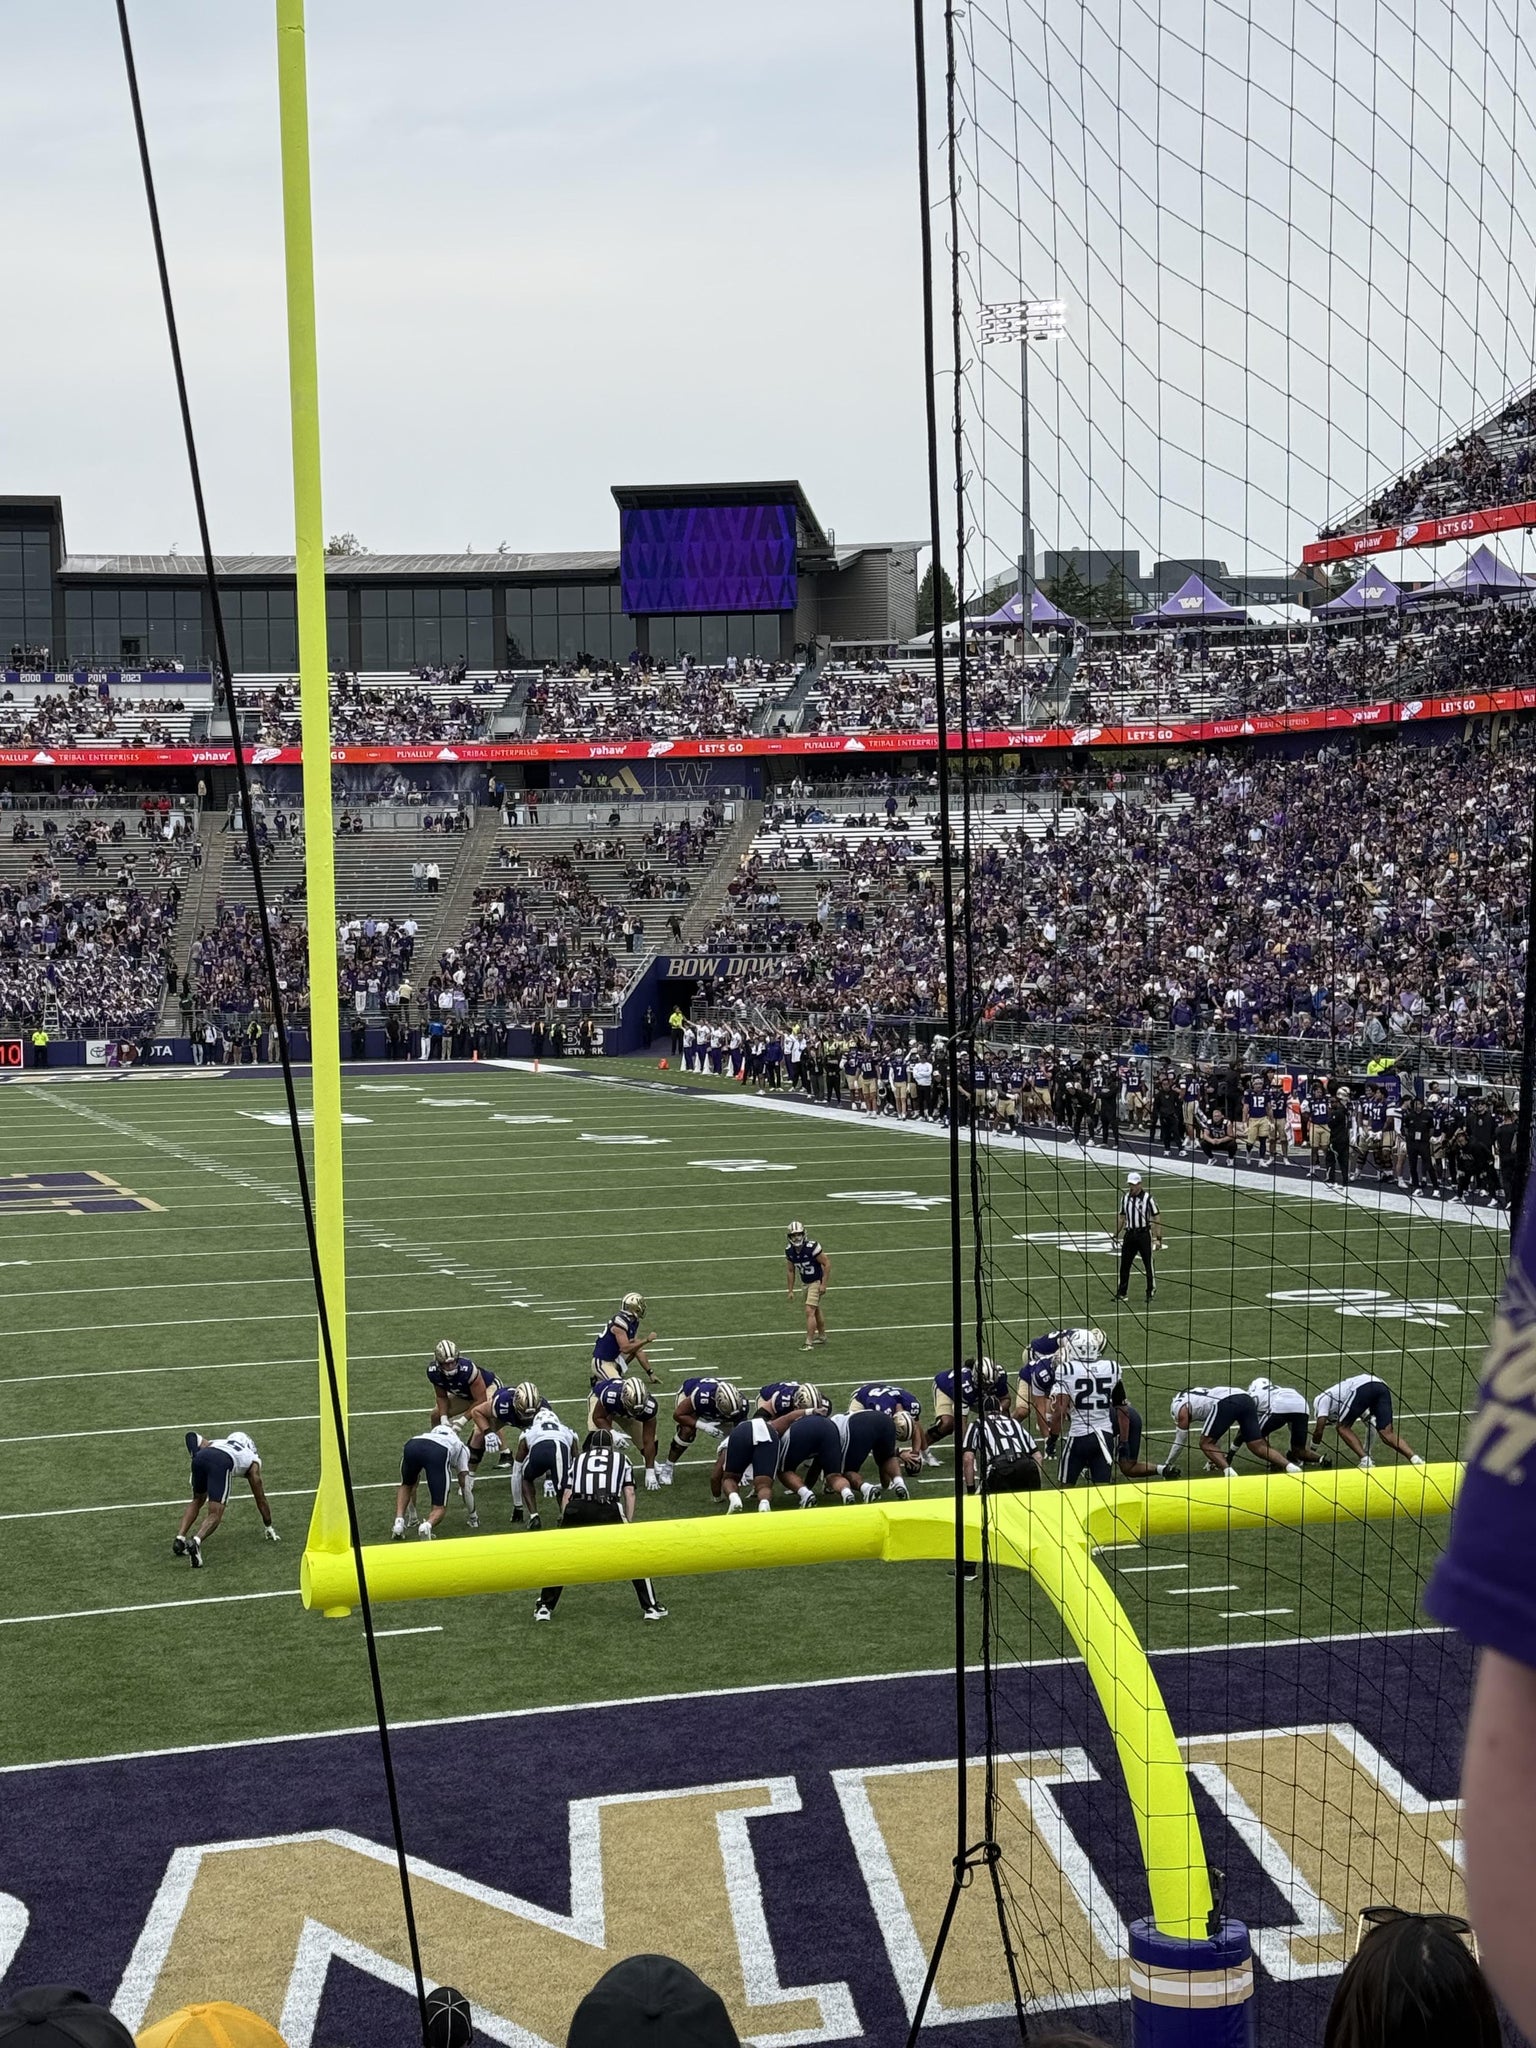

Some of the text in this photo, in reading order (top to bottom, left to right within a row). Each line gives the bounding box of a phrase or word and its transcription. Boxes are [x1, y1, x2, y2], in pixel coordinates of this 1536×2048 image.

[1438, 520, 1474, 535] LET'S GO
[20, 674, 41, 682] 2000
[55, 674, 73, 682] 2016
[121, 674, 141, 682] 2023
[1441, 700, 1475, 713] LET'S GO
[1127, 730, 1173, 740] LET'S GO
[699, 744, 744, 753] LET'S GO
[804, 739, 938, 750] PUYALLUP TRIBAL ENTERPRIS
[330, 751, 346, 760] GO
[396, 748, 539, 759] PUYALLUP TRIBAL ENTERPRISES
[666, 958, 721, 977] BOW
[563, 1026, 604, 1046] BG
[563, 1047, 604, 1055] NETWRK
[897, 1066, 903, 1076] 7
[1253, 1096, 1265, 1108] 12
[700, 1391, 710, 1405] 76
[1074, 1377, 1112, 1410] 25
[499, 1402, 509, 1415] 70
[910, 1402, 919, 1416] 53
[587, 1455, 608, 1472] C
